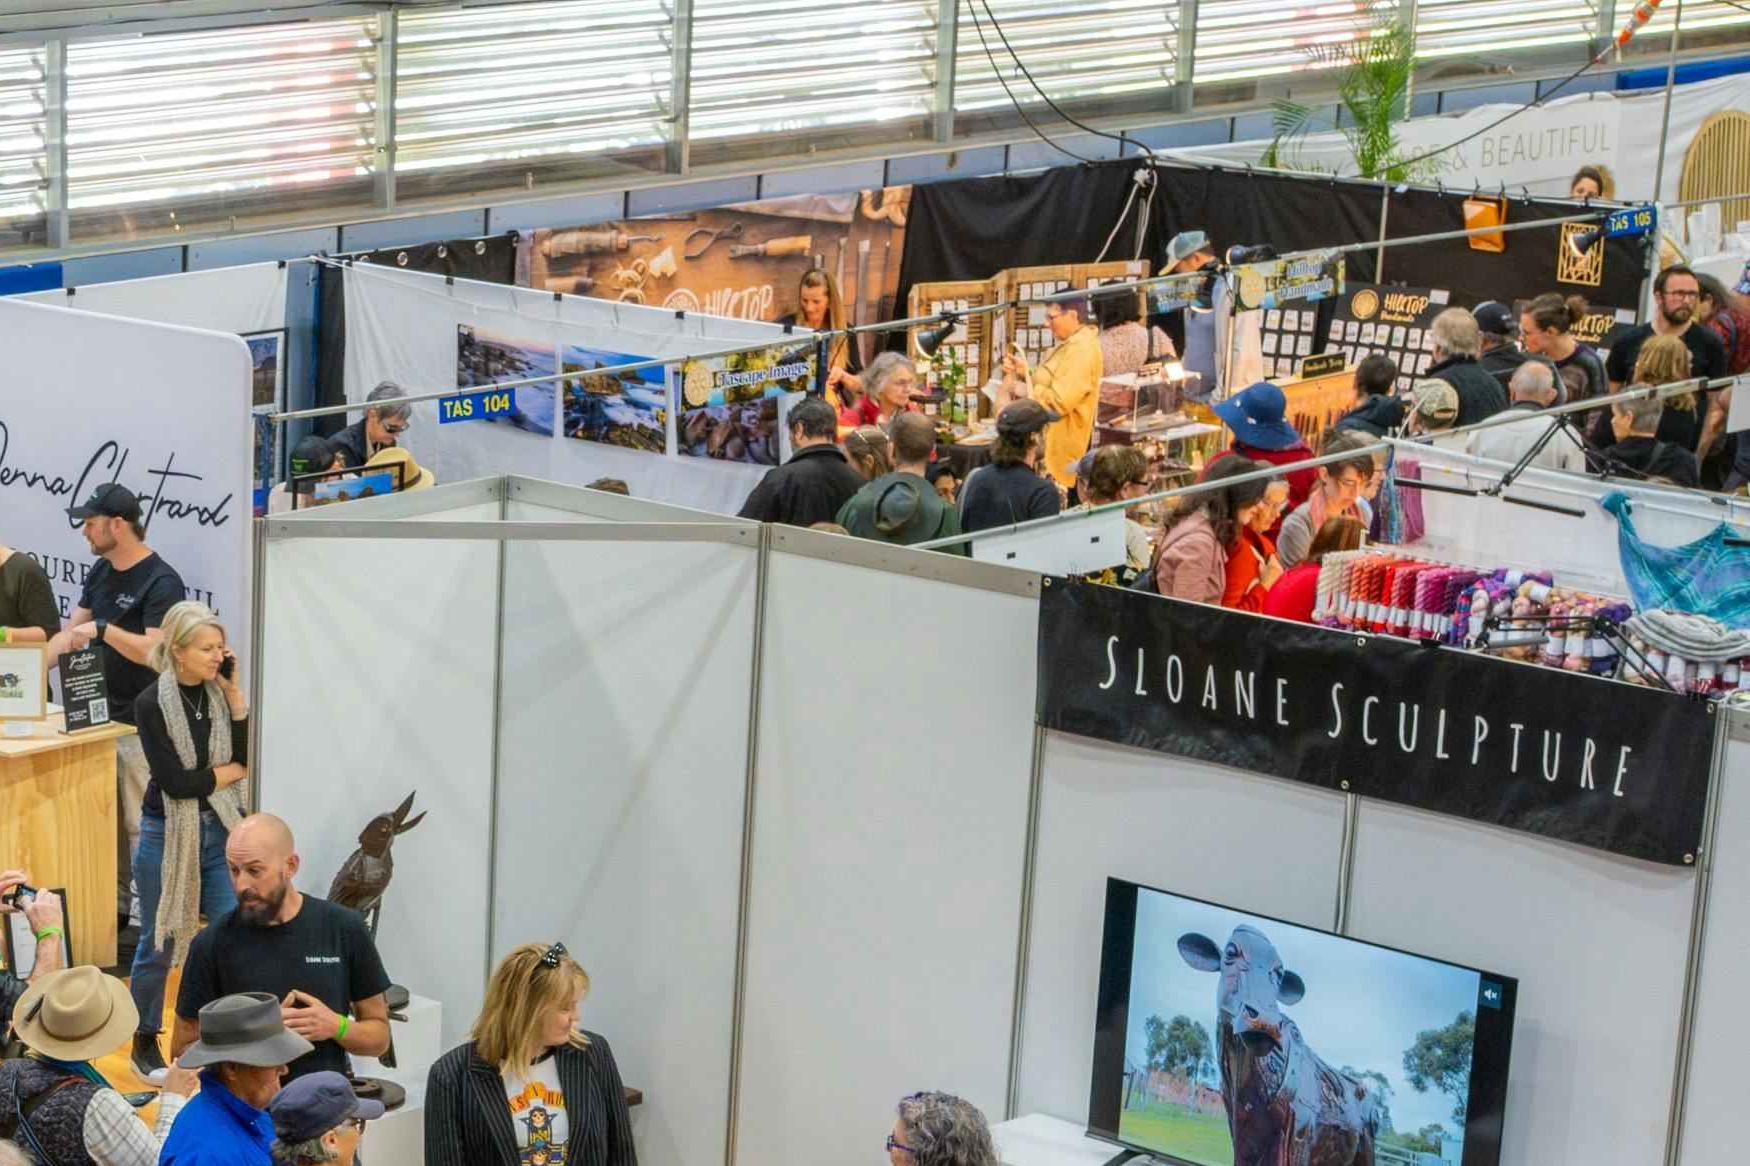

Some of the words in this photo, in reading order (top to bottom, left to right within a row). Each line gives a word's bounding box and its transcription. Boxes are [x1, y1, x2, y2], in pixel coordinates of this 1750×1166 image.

[1481, 122, 1610, 168] BEAUTIFUL
[1611, 215, 1629, 231] TAS
[1634, 211, 1652, 227] 105
[1286, 261, 1323, 280] Hilltop
[1279, 277, 1334, 299] Handmade
[718, 367, 766, 390] Tascape
[769, 359, 811, 381] Images
[444, 399, 473, 419] TAS
[482, 394, 511, 414] 104
[1098, 634, 1290, 727] SLOANE
[1328, 682, 1632, 797] SCULPTURE
